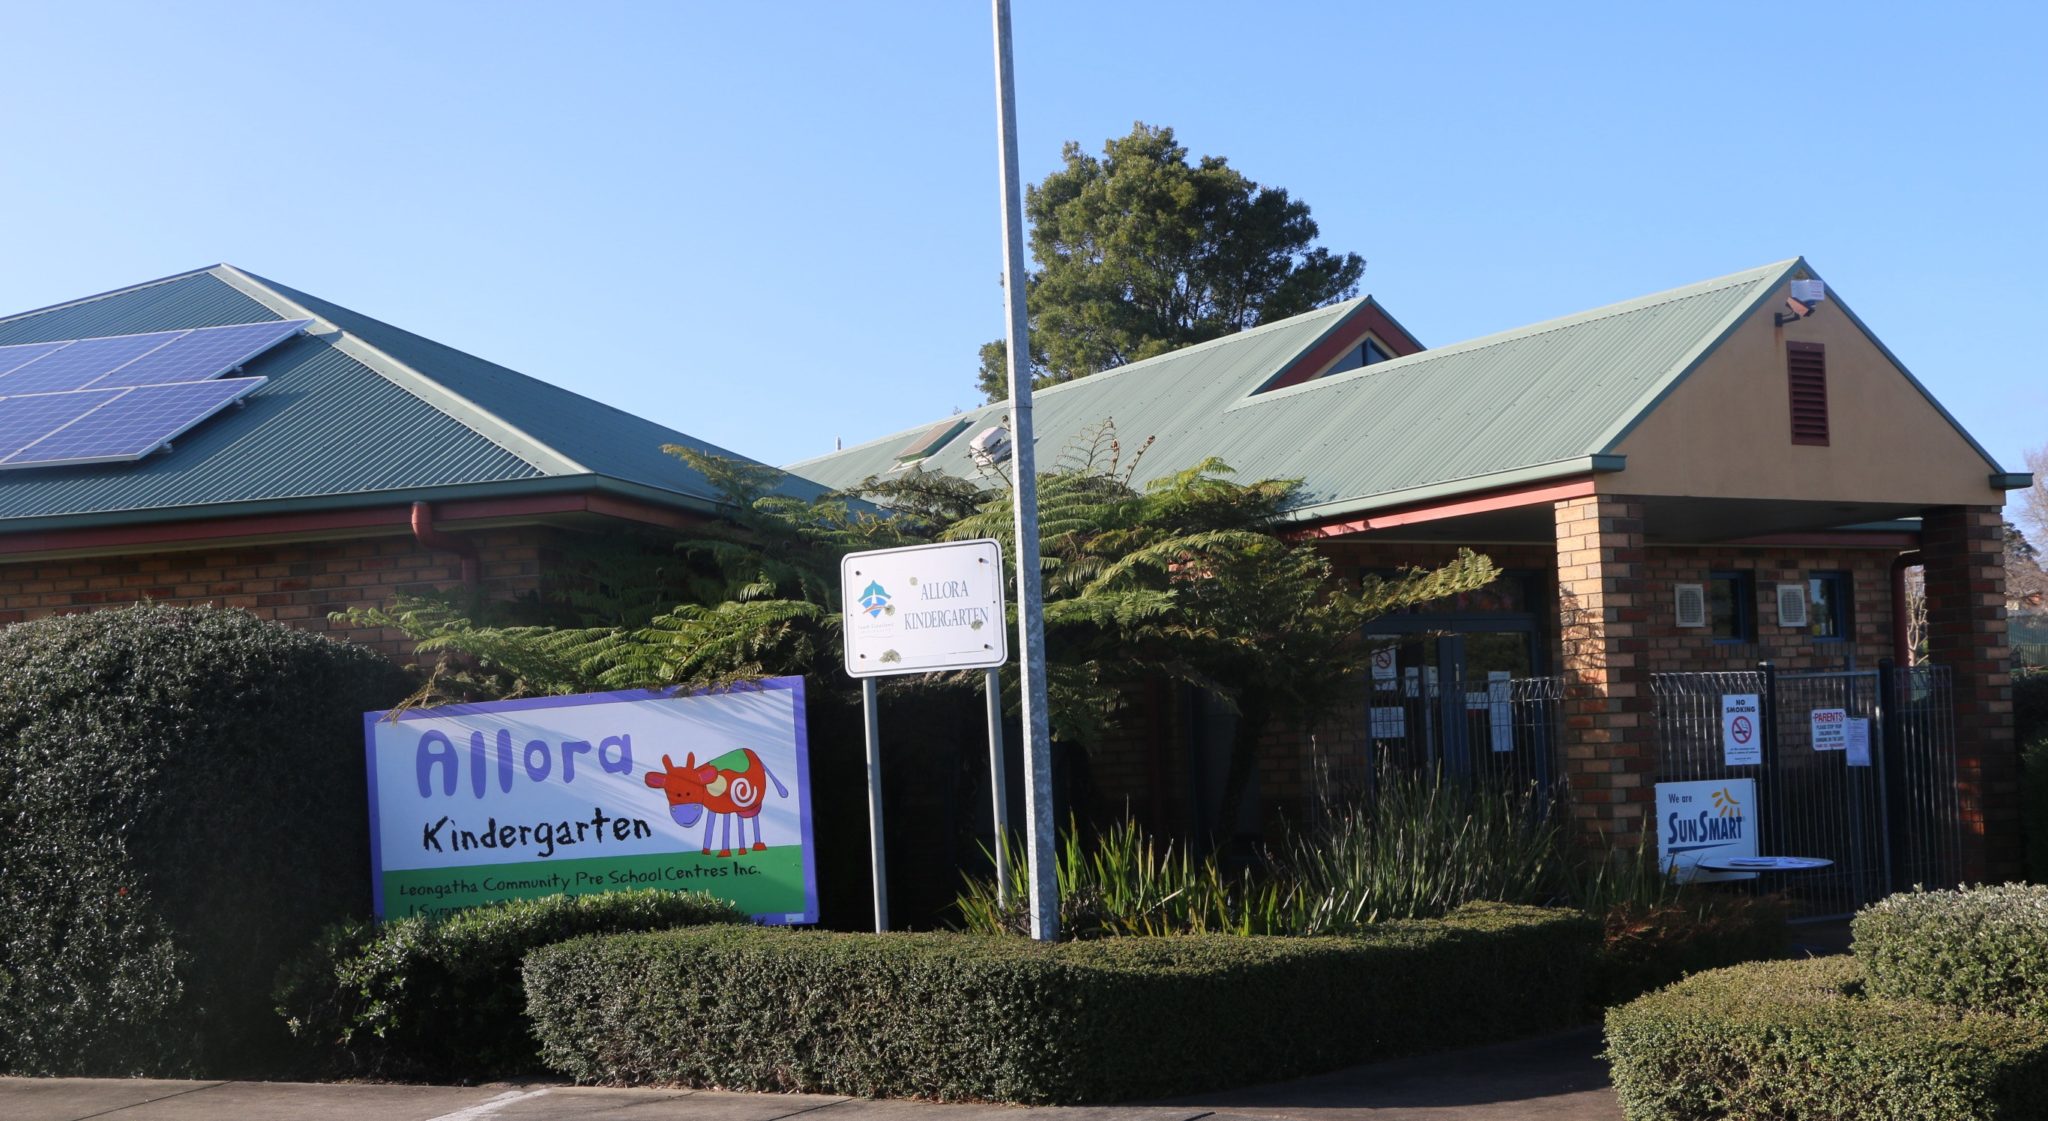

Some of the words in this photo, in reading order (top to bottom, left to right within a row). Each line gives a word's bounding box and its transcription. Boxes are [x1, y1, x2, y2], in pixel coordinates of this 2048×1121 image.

[921, 580, 969, 600] ALLORA
[904, 607, 989, 631] KINDERGARTEN
[1814, 712, 1844, 723] PARENTS
[416, 729, 633, 799] Allora
[1668, 793, 1679, 803] We
[1682, 795, 1692, 803] are
[423, 807, 652, 857] Kindergarten
[400, 879, 479, 899] Leongatha
[483, 873, 570, 891] Community
[576, 871, 603, 885] Pre
[608, 867, 662, 884] School
[665, 864, 728, 880] Centres
[733, 861, 761, 876] Inc.
